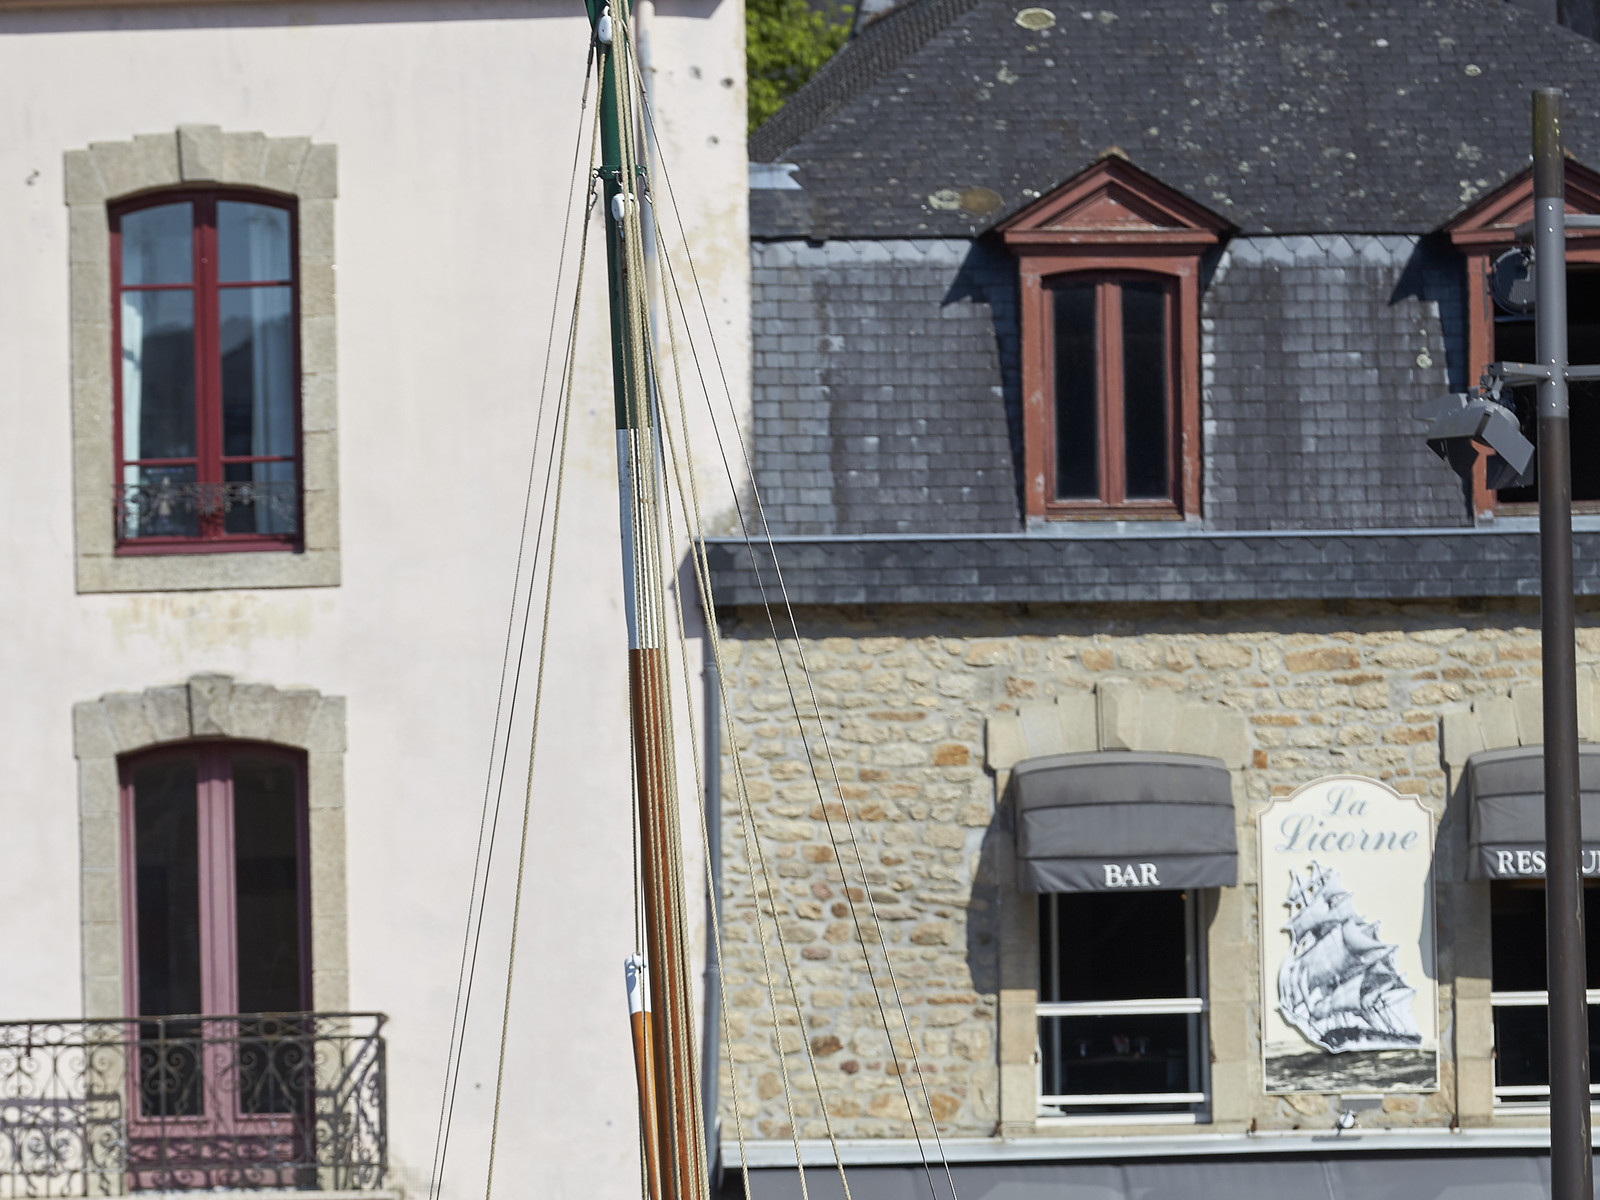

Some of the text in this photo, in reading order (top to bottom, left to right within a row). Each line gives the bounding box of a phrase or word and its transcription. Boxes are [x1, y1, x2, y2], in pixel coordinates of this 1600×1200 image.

[1322, 784, 1368, 817] La
[1274, 813, 1418, 854] Licorne
[1102, 862, 1161, 888] BAR
[1496, 850, 1600, 875] RESU
